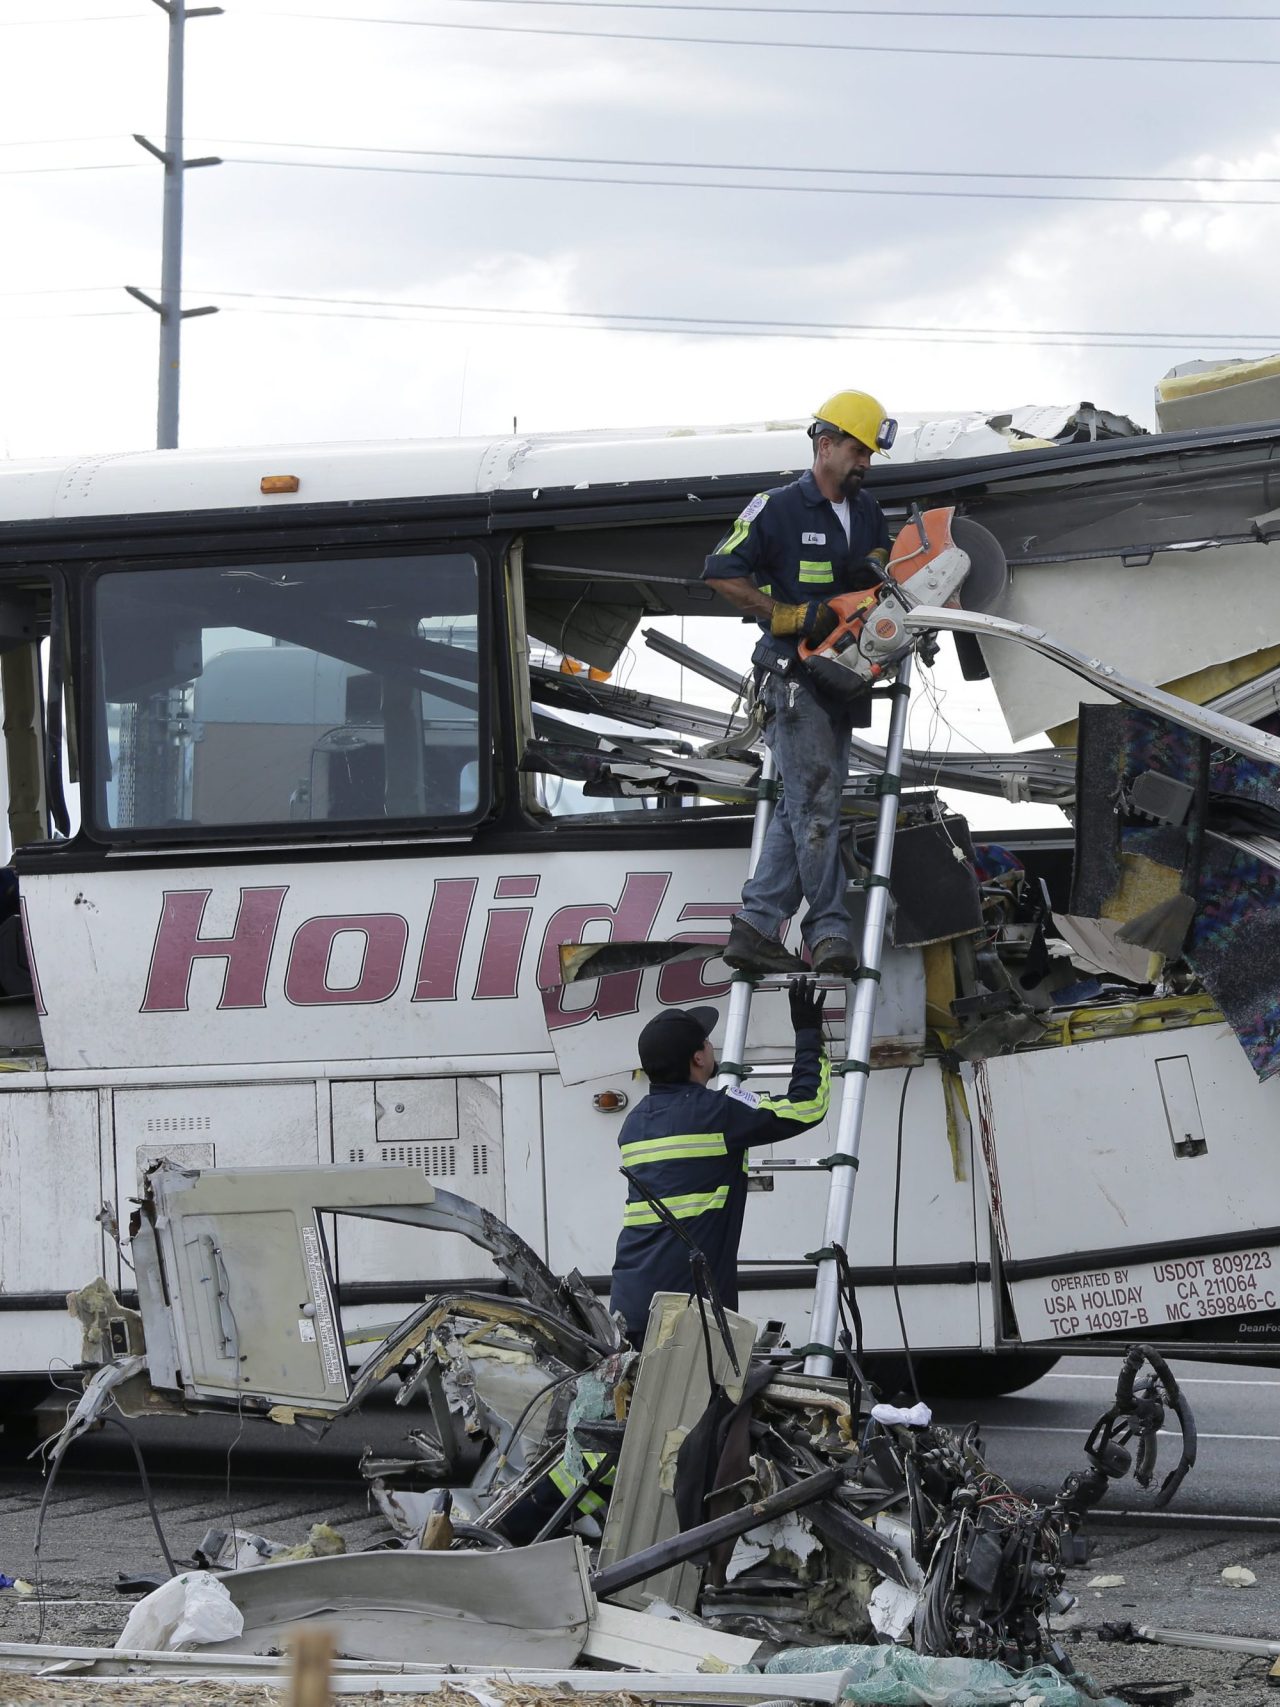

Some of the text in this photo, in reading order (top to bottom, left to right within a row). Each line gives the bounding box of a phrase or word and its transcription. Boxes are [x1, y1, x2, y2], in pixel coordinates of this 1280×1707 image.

[304, 1236, 314, 1262] OPERATION
[309, 1264, 319, 1290] PROHIBITS
[1153, 1251, 1272, 1283] USDOT 809223
[315, 1271, 326, 1294] FORWARD
[1051, 1269, 1129, 1292] OPERATED BY
[1177, 1273, 1257, 1300] CA 211064
[313, 1289, 321, 1301] LAW
[1044, 1286, 1142, 1315] USA HOLIDAY
[1166, 1290, 1276, 1321] MC 359846-C
[1050, 1308, 1149, 1335] TCP 14097-B
[325, 1326, 334, 1345] ANYONE
[323, 1343, 333, 1373] PASSENGER
